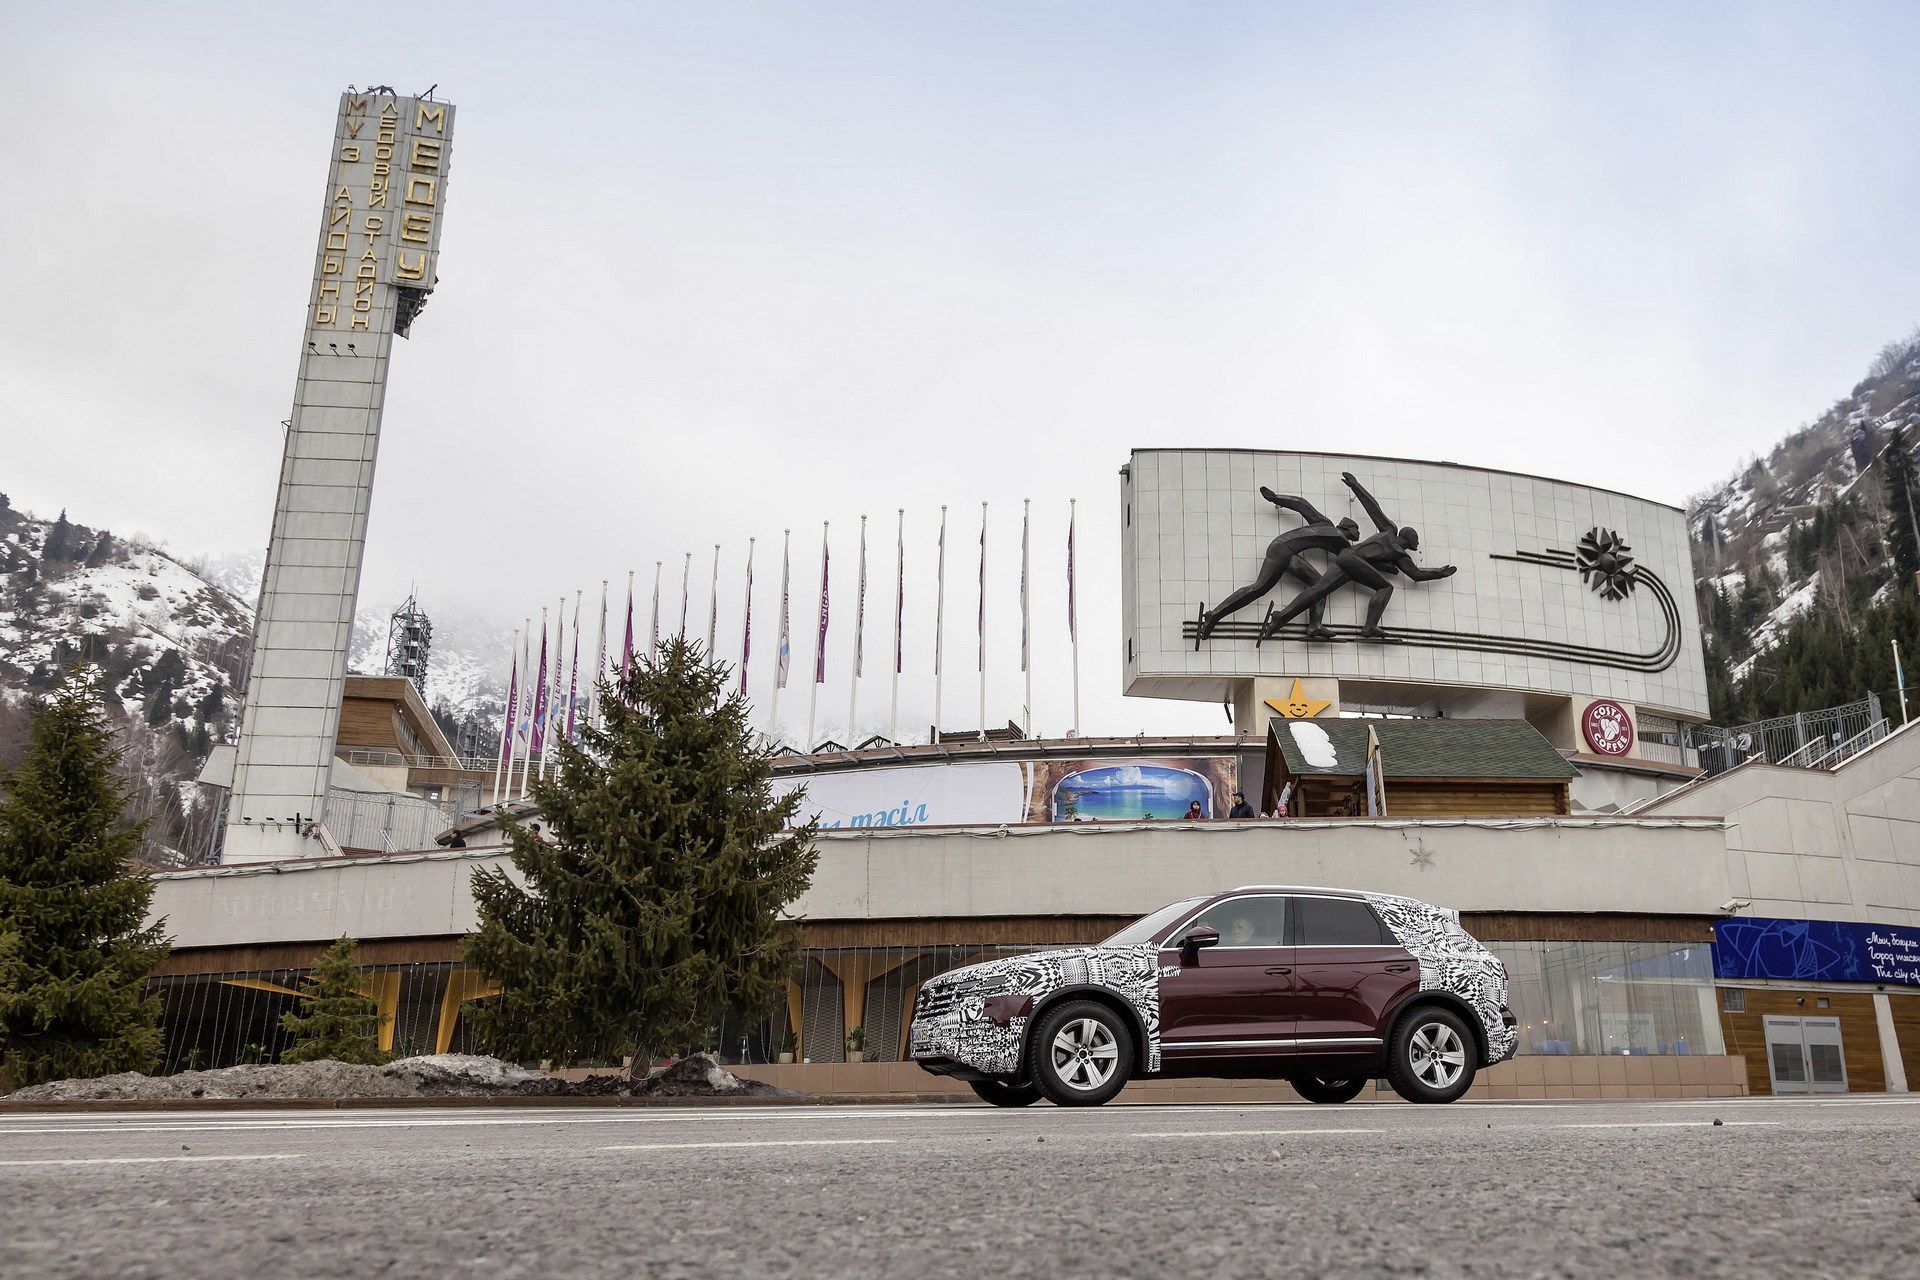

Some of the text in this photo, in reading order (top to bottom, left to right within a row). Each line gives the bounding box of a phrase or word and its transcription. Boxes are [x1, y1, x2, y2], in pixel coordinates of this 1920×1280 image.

[397, 104, 446, 280] МЕДЕУ
[351, 101, 398, 330] ЛЕДОВЫЙ СТАДИОН
[316, 184, 353, 325] АЙДЫНЫ
[1594, 706, 1622, 722] COSTA
[1594, 732, 1628, 752] COFFEE
[1867, 945, 1896, 966] Город
[1871, 964, 1893, 978] The
[1894, 968, 1908, 983] city
